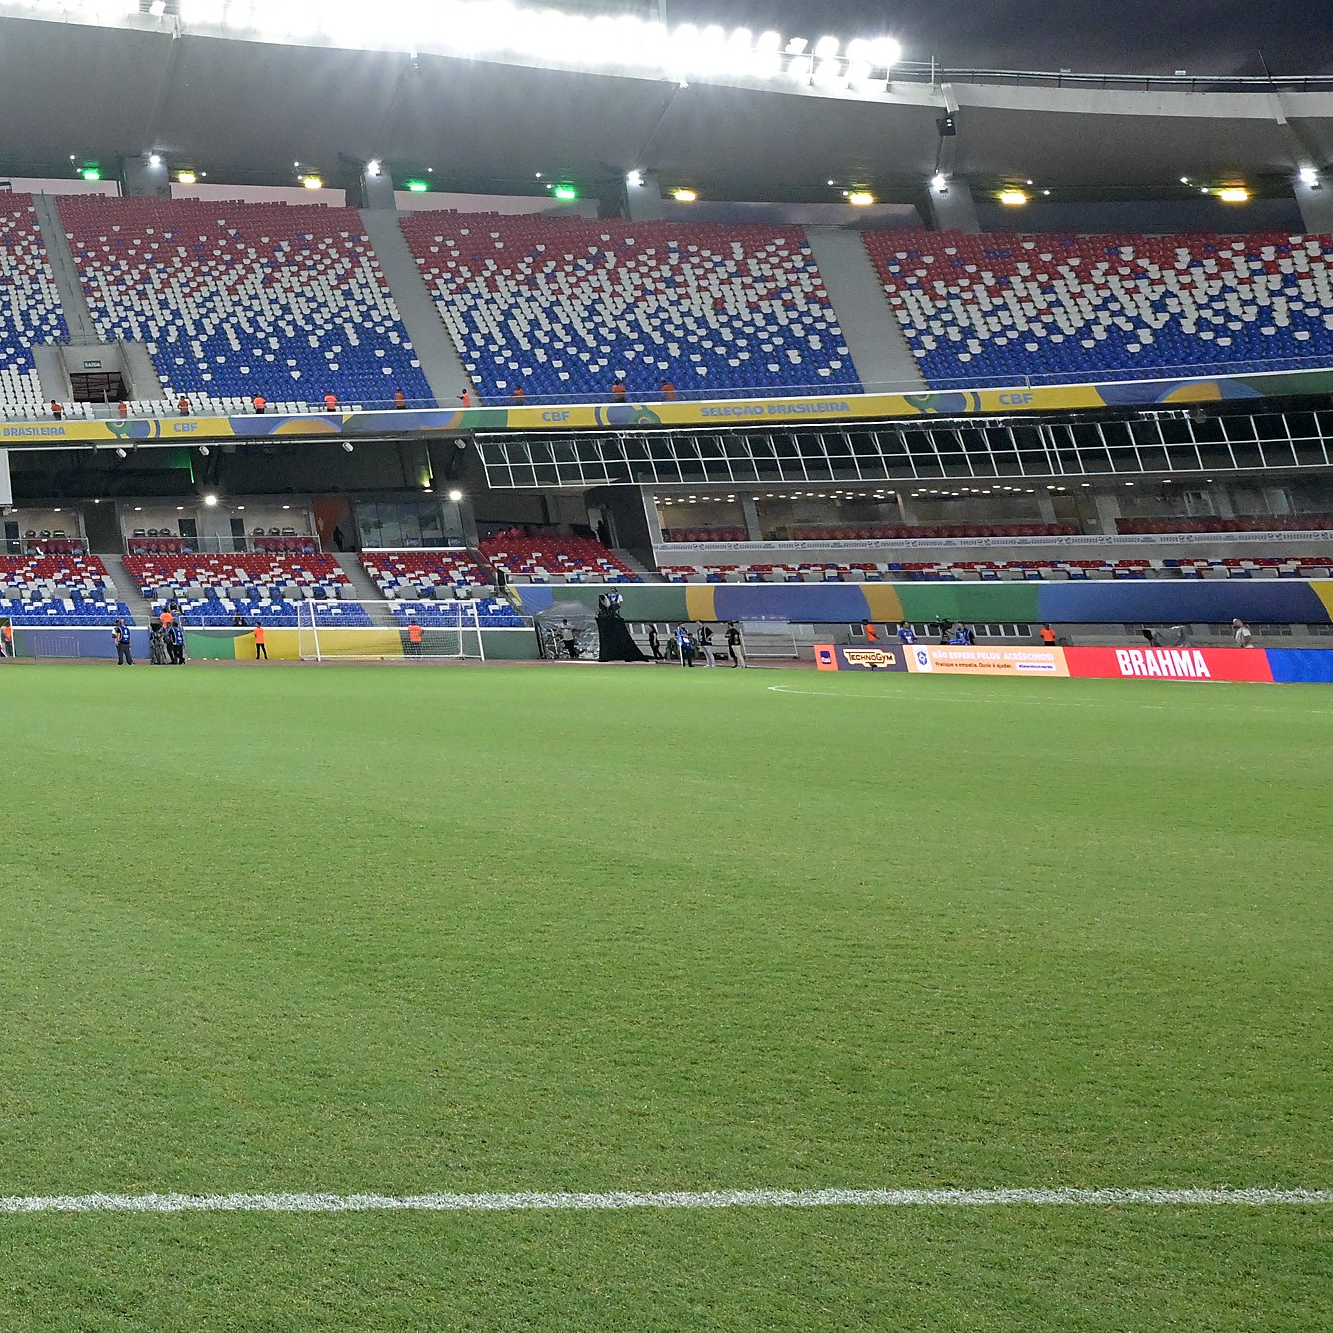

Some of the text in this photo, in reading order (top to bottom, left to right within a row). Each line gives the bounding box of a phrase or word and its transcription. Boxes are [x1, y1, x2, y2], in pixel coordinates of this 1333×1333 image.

[999, 393, 1033, 404] CBF
[767, 402, 851, 415] BRASILEIRA
[542, 411, 570, 422] CBF
[3, 427, 66, 437] BRASILEIRA
[174, 422, 197, 433] CBF
[1115, 650, 1211, 677] BRAHMA
